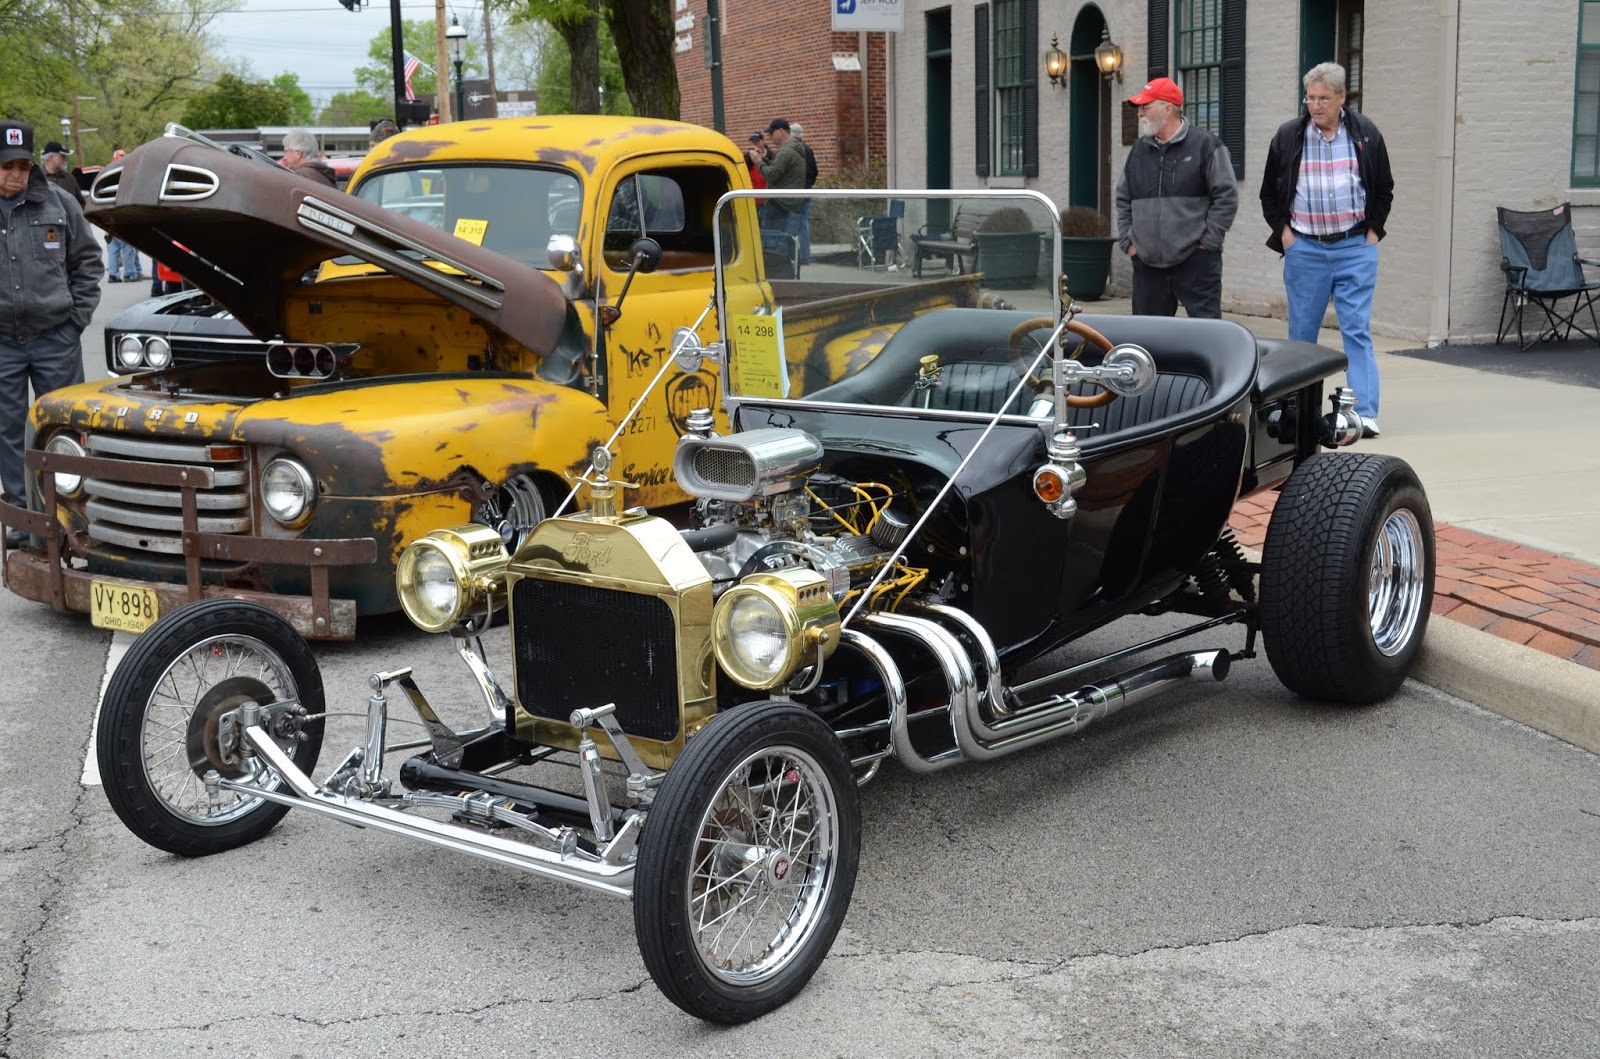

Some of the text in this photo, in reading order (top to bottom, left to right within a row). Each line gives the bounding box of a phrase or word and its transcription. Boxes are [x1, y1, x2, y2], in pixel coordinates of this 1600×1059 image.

[469, 227, 483, 235] 310
[737, 325, 774, 337] 14 298
[622, 463, 669, 487] Service
[562, 531, 612, 569] Ford
[104, 615, 122, 627] OHIO
